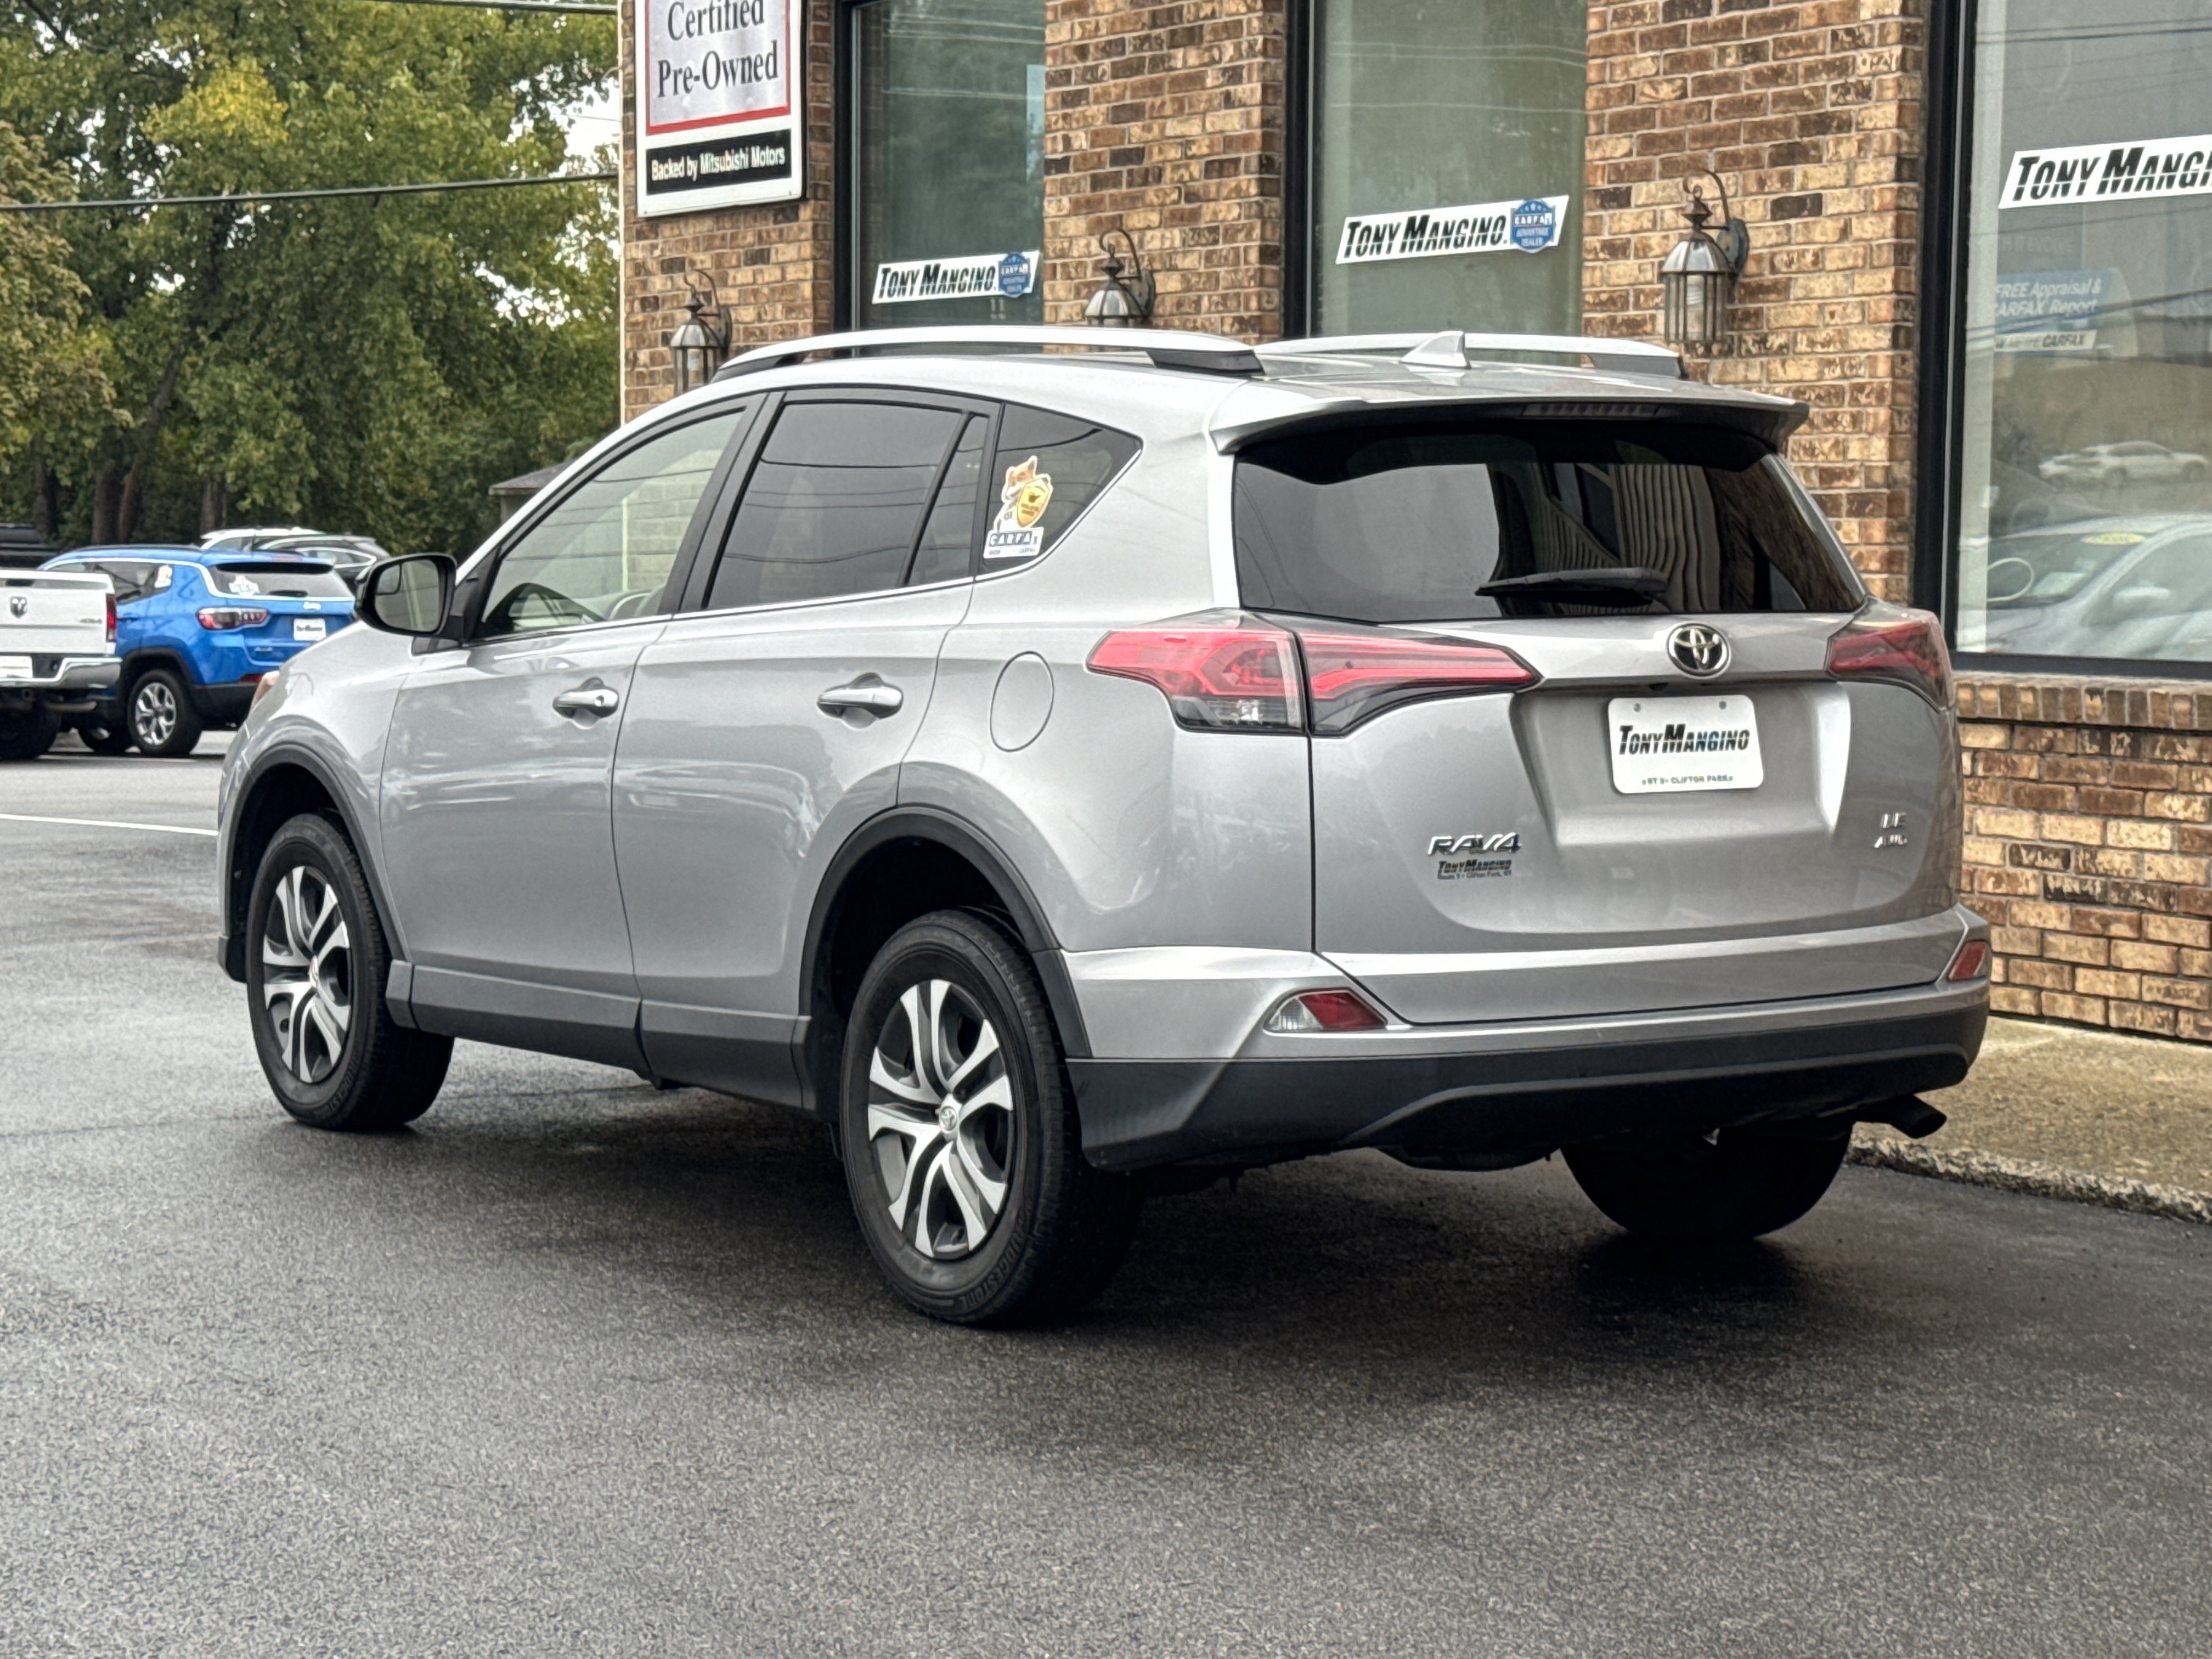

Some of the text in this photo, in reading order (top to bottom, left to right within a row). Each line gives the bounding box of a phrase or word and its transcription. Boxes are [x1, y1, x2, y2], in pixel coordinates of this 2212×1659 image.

[668, 0, 765, 41] Certified
[658, 39, 778, 98] Pre-Owned
[651, 145, 785, 182] Backed by Mitsubishi Motors
[2012, 156, 2101, 201] TONY
[1344, 221, 1402, 258] TONY
[878, 267, 921, 298] TONY
[1427, 832, 1522, 856] RAV4
